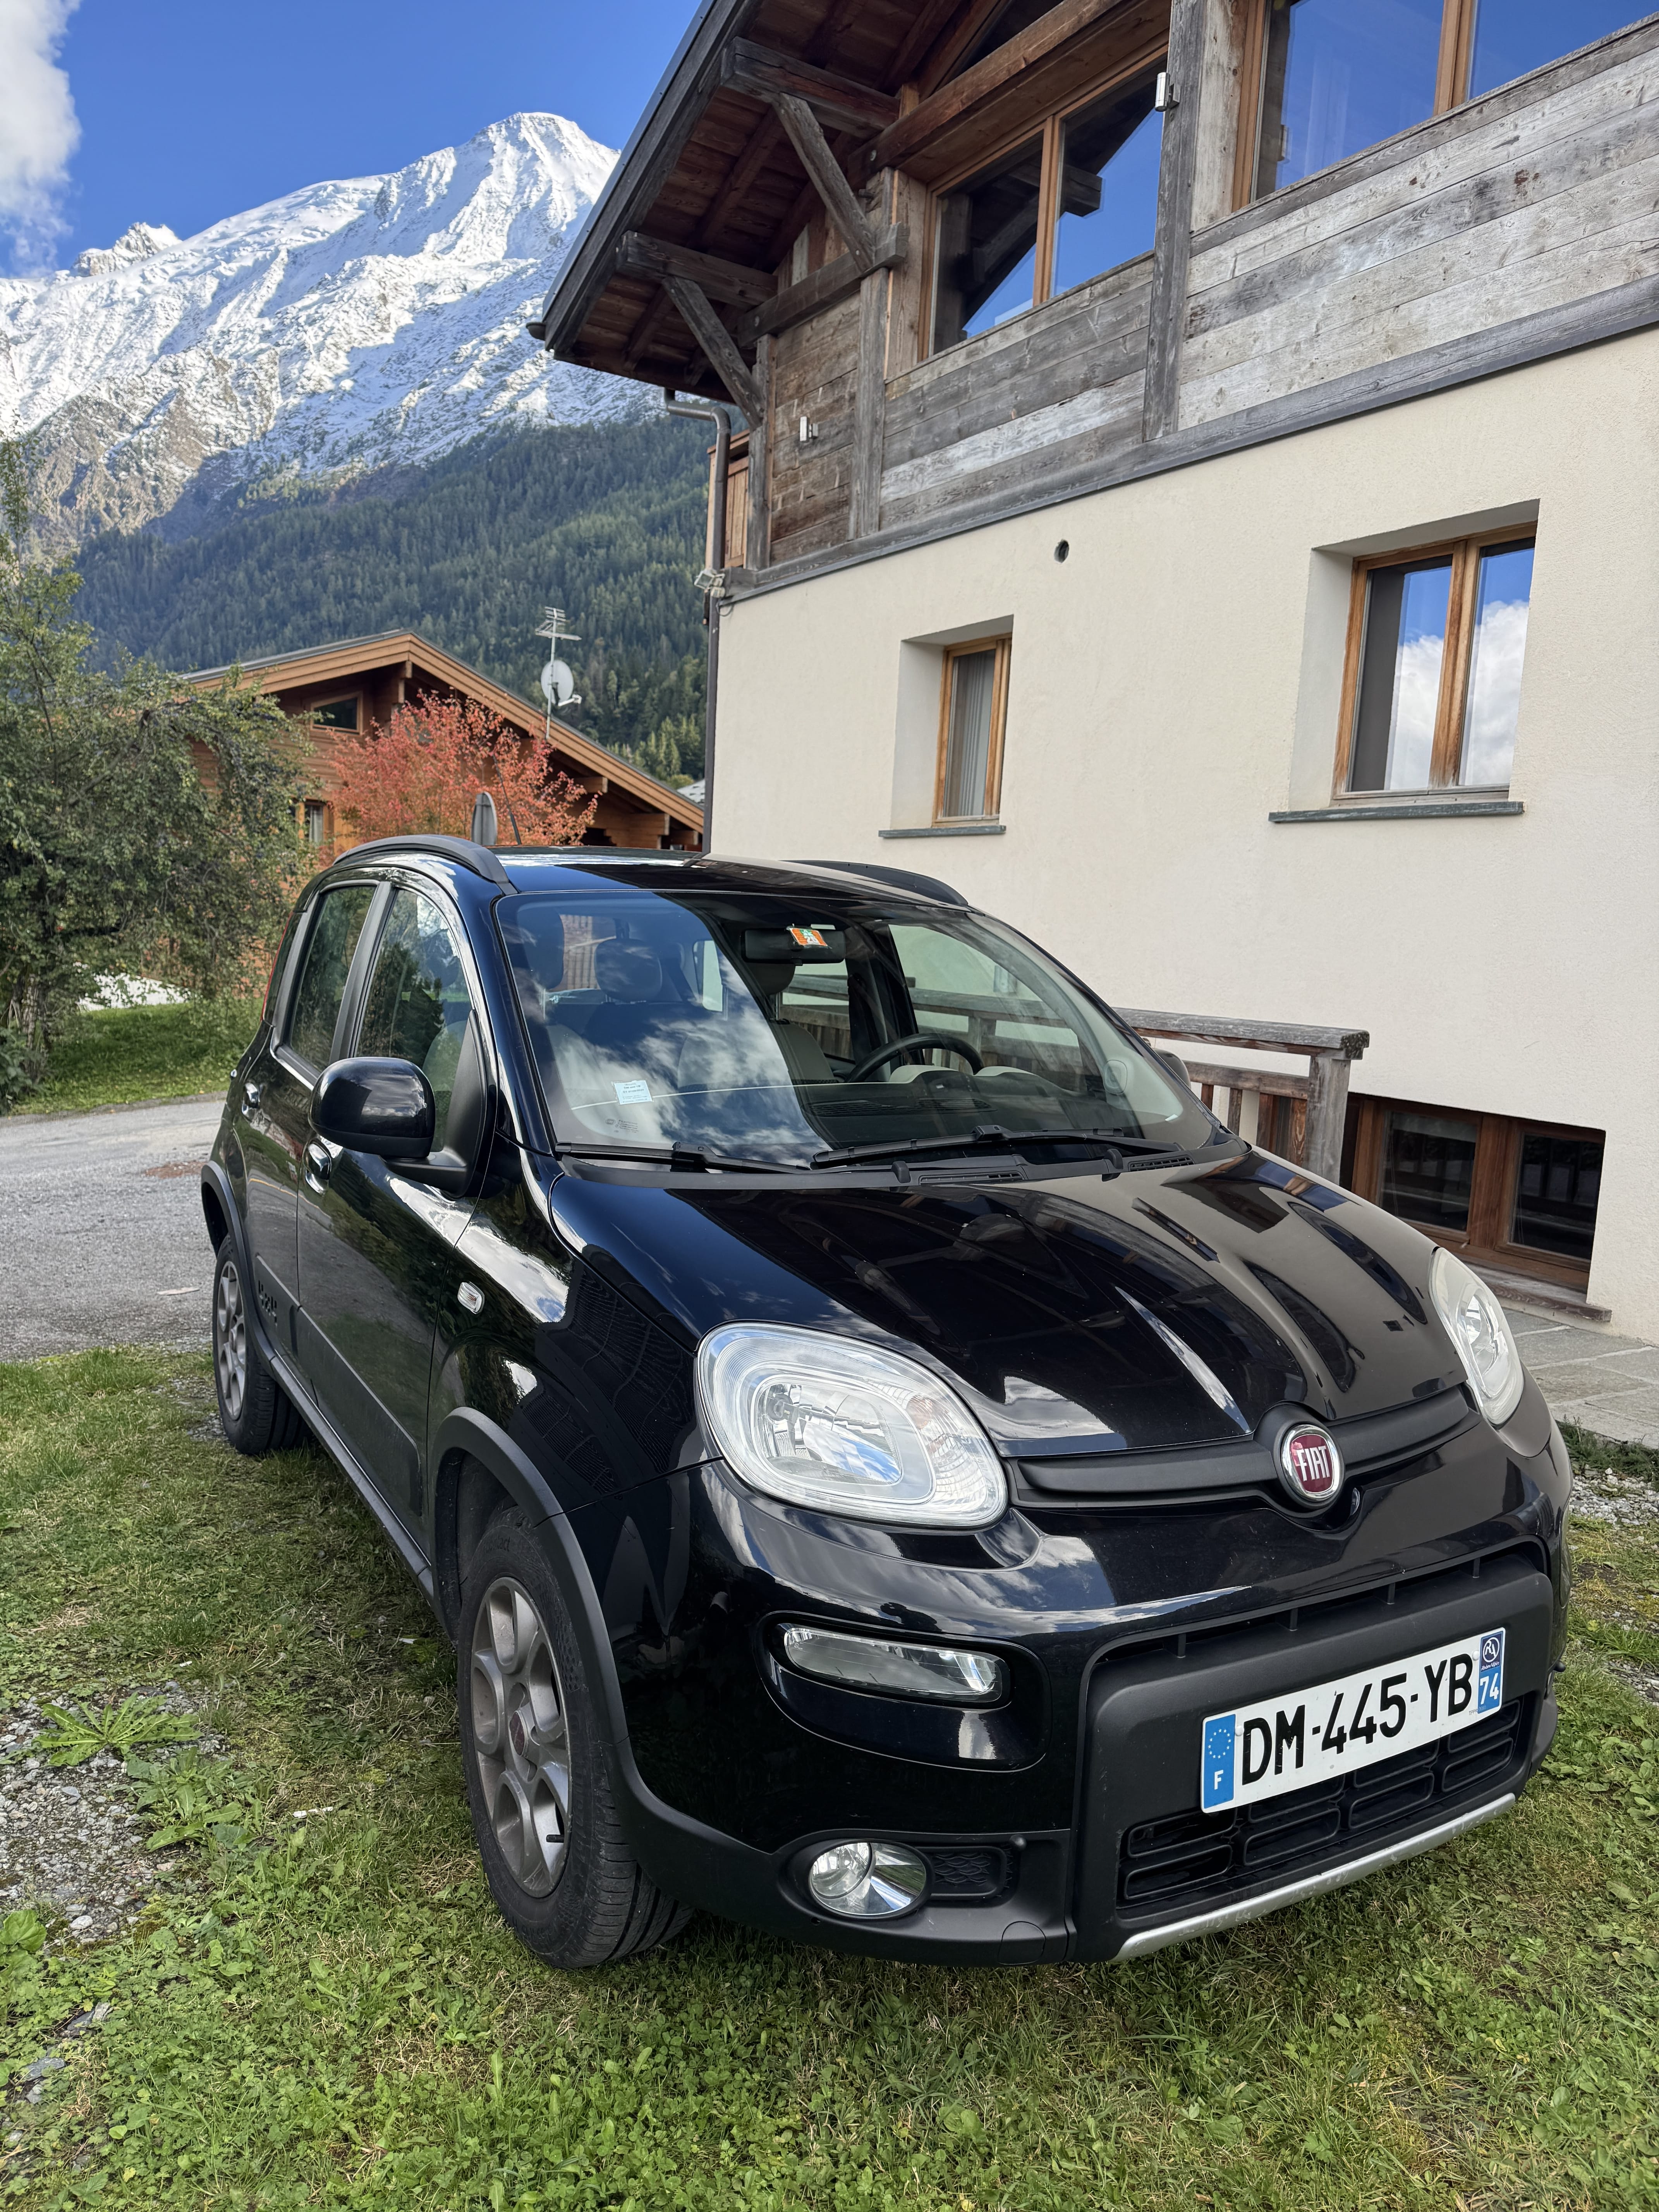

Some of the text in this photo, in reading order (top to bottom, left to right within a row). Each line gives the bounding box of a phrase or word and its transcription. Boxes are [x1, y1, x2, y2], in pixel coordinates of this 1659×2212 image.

[1297, 1446, 1330, 1482] FIAT
[1480, 1673, 1499, 1705] 74
[1242, 1653, 1473, 1785] DM-445-YB
[1214, 1769, 1224, 1790] F
